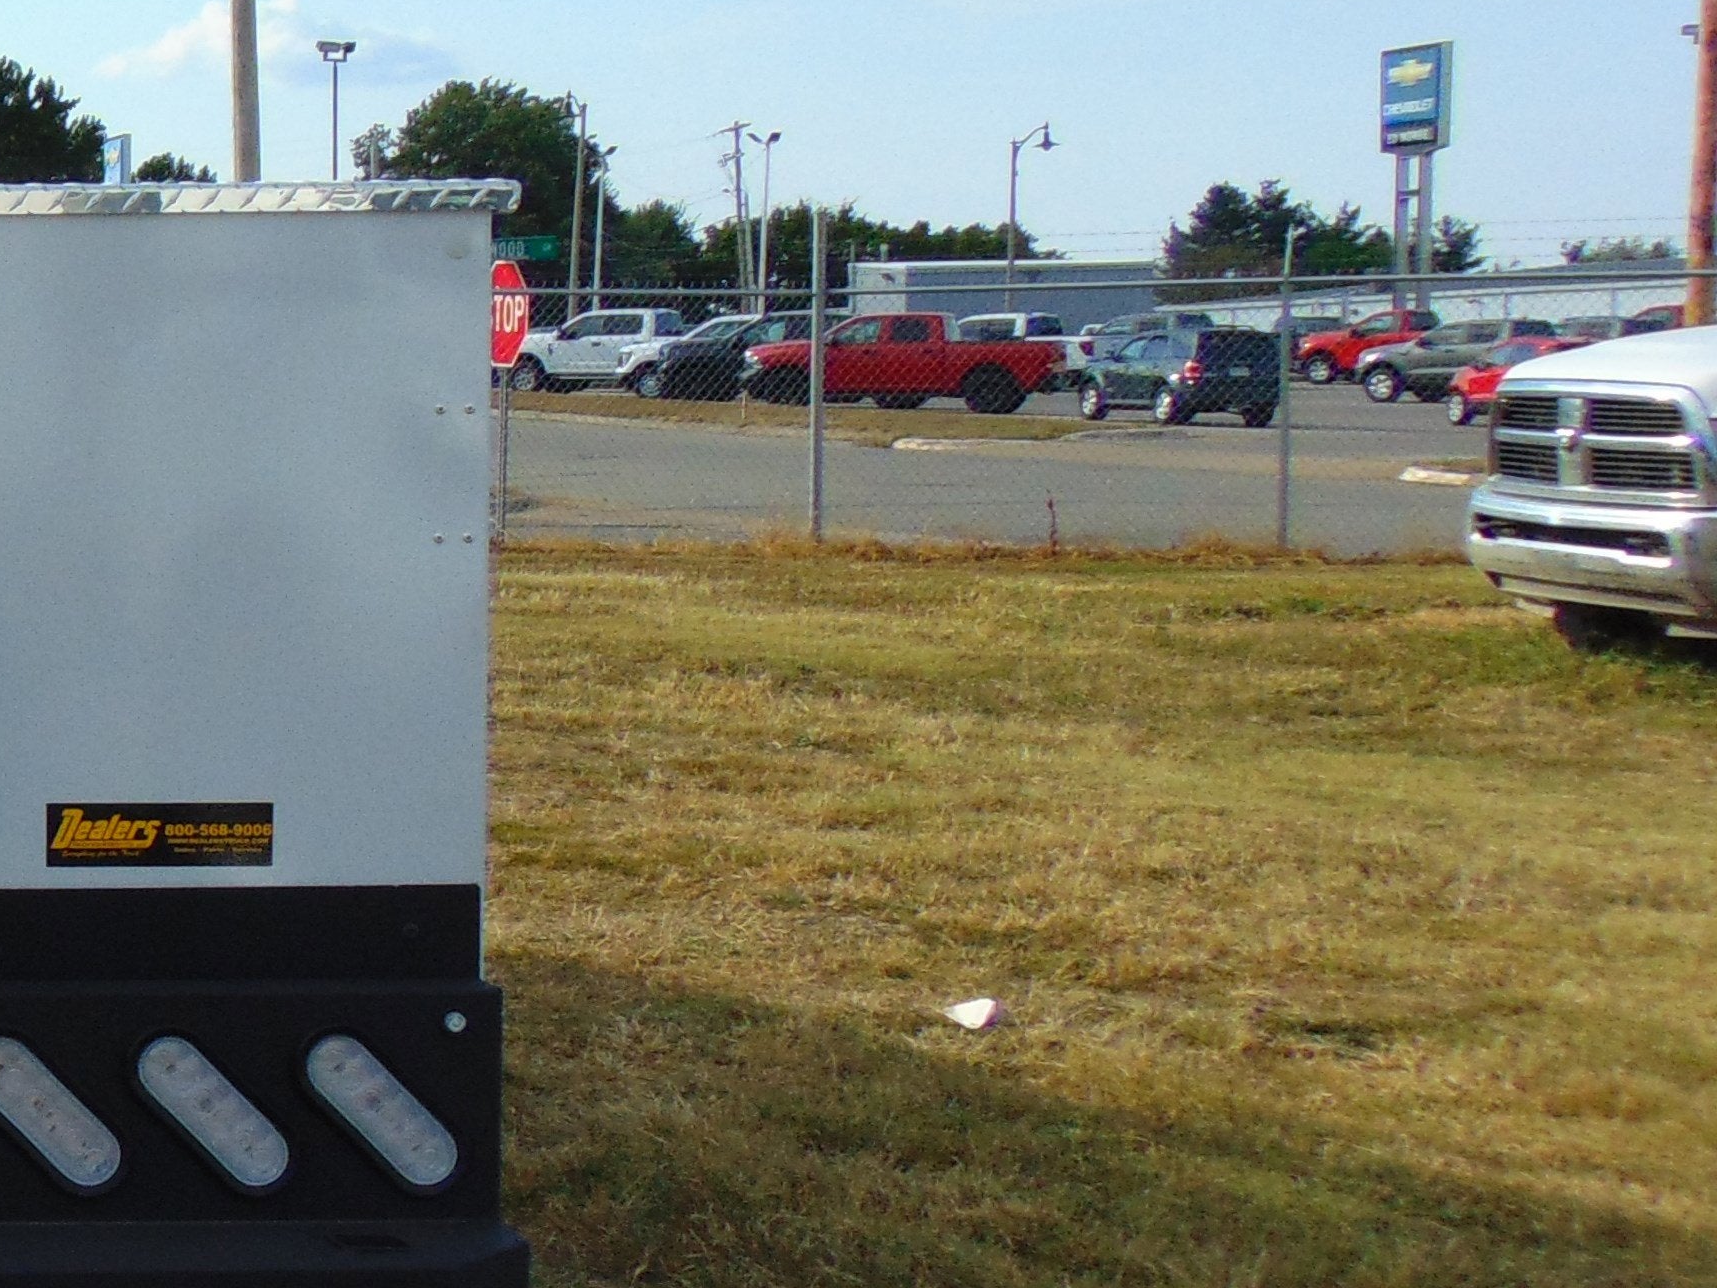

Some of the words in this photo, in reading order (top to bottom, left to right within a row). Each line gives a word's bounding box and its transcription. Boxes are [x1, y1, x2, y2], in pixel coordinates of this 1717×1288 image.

[493, 294, 525, 333] TOP
[50, 807, 162, 850] Dealers
[164, 823, 273, 837] 800-568-9006
